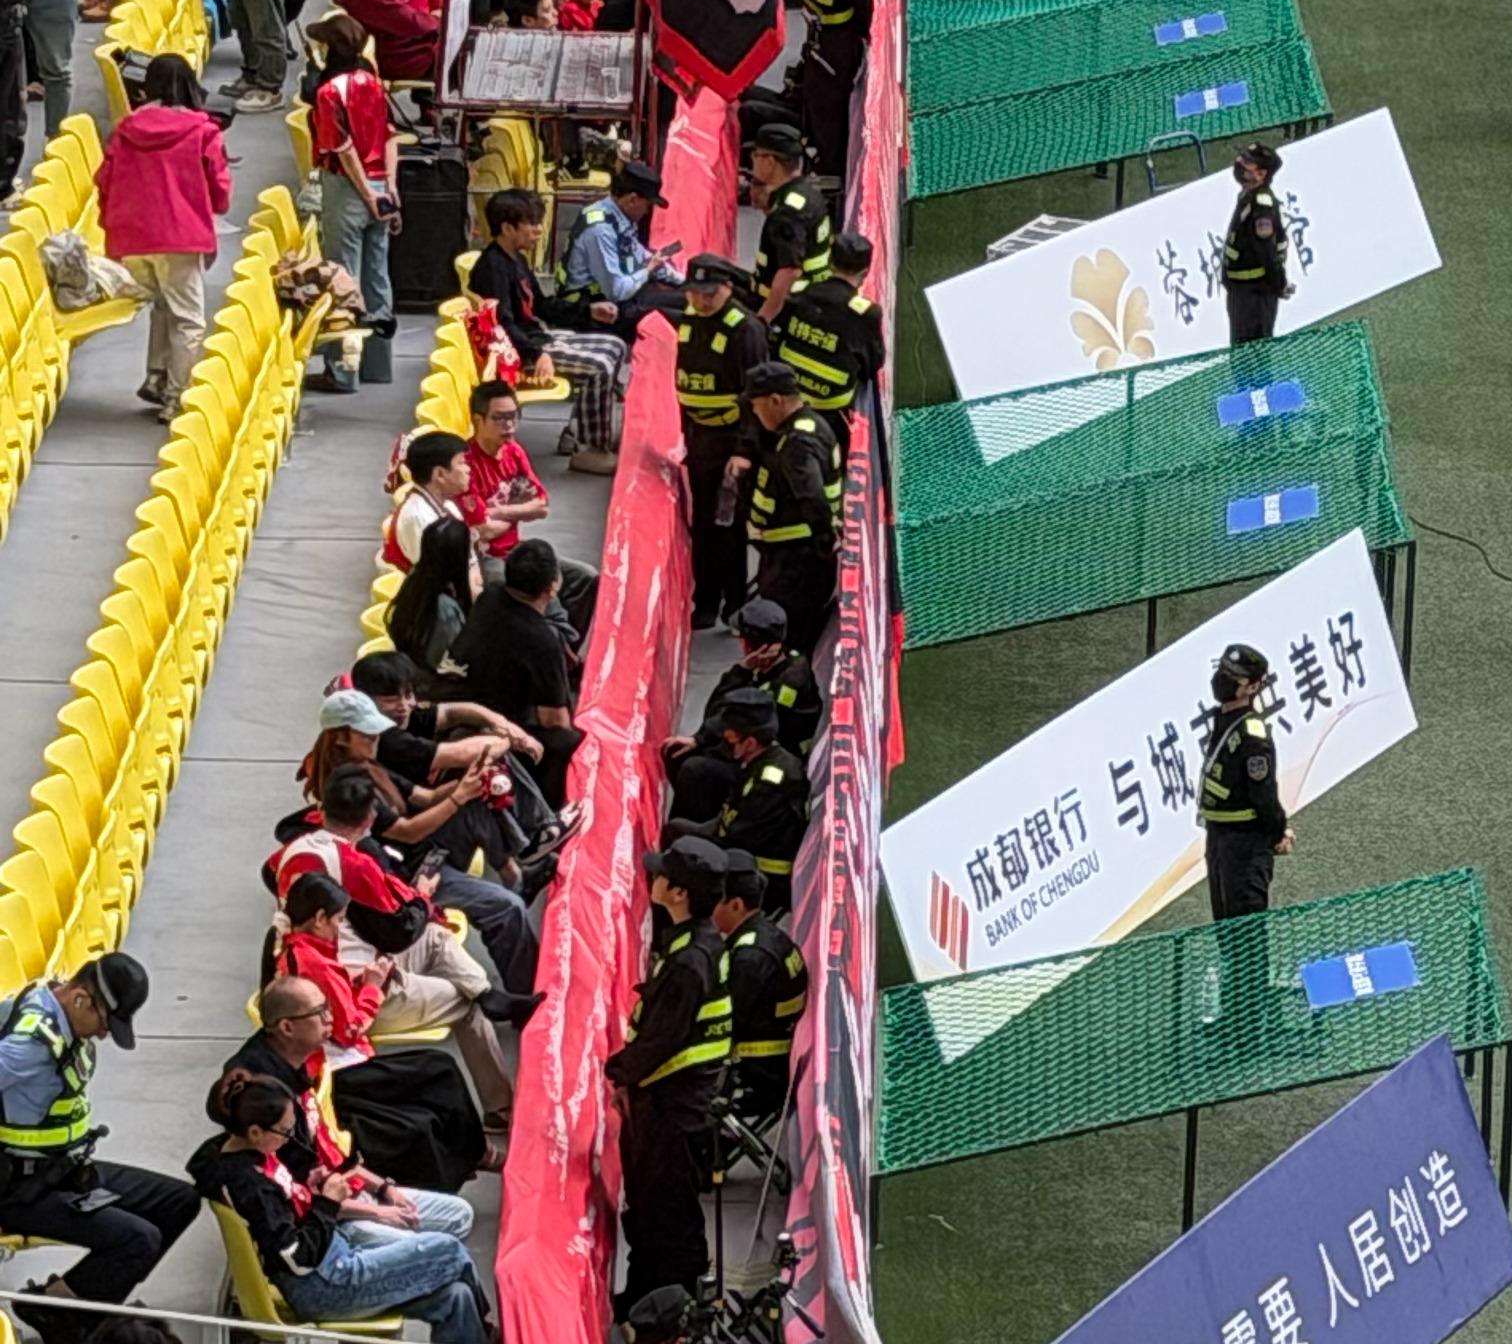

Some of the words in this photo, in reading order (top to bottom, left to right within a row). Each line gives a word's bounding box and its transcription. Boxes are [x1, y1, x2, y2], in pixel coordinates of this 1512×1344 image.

[966, 787, 1088, 913] 成都银行
[984, 905, 1023, 948] BANK
[1020, 891, 1039, 922] OF
[1037, 848, 1101, 908] CHENGDU
[1316, 1148, 1470, 1330] 人居创造
